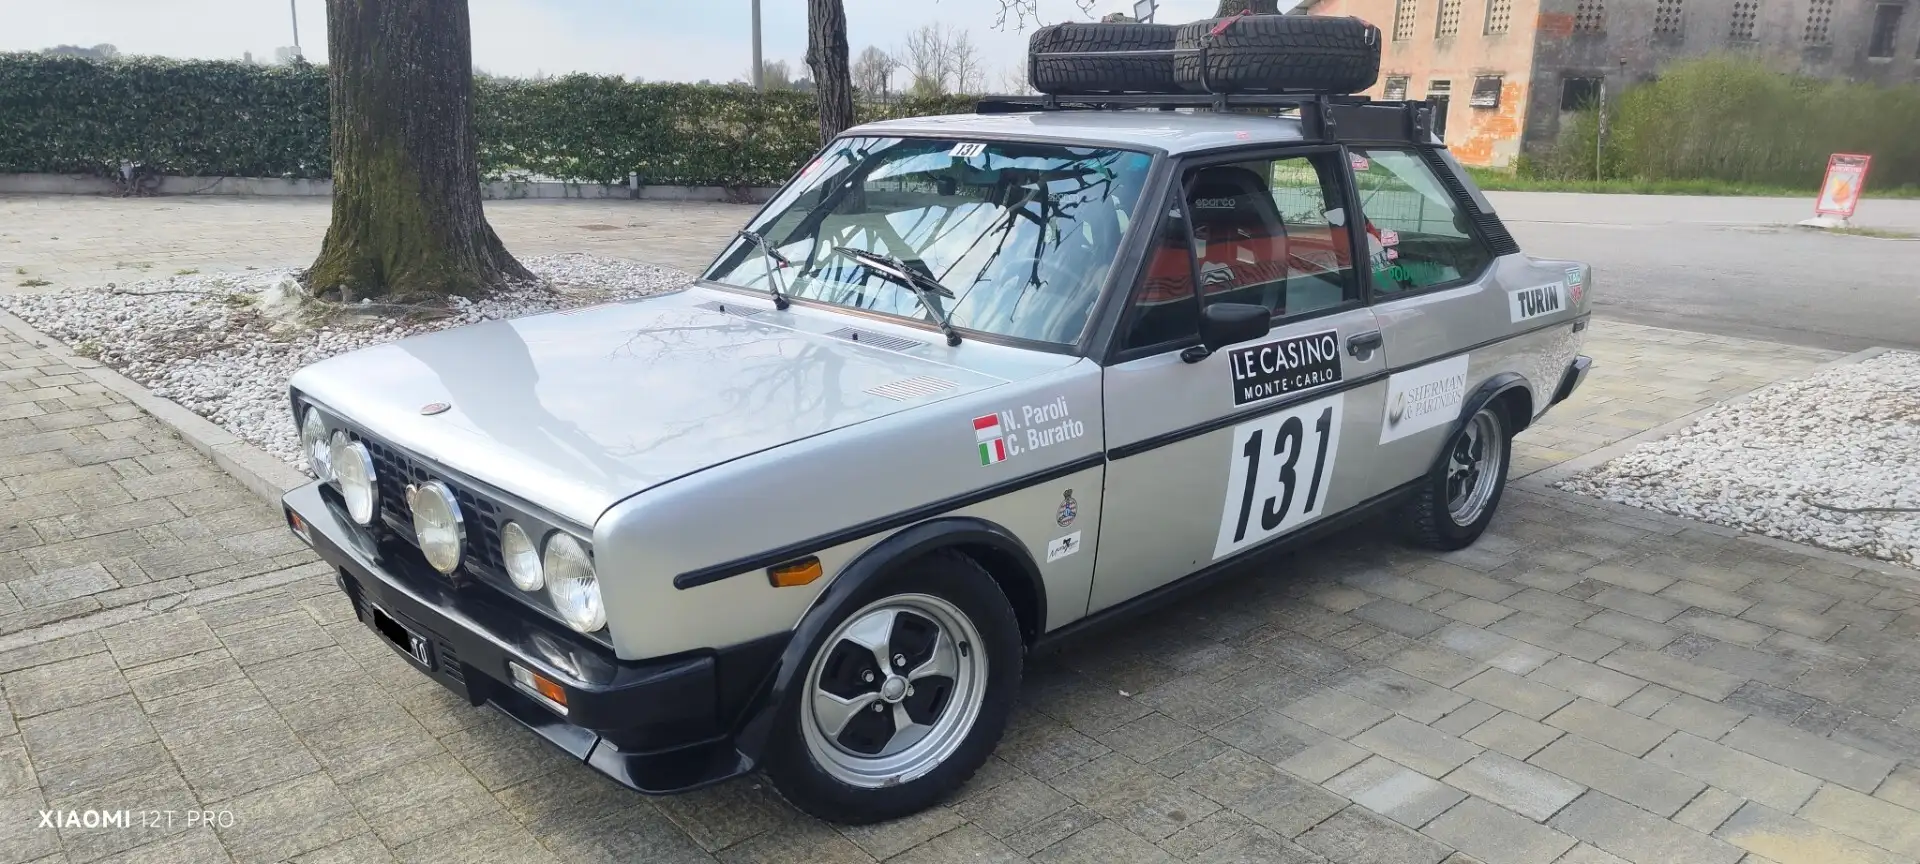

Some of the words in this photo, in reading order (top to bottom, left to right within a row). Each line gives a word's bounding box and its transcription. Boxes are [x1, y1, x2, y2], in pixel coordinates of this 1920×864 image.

[956, 144, 980, 156] 131
[1517, 285, 1559, 318] TURIN
[1233, 351, 1257, 380] LE
[1260, 335, 1336, 374] CASINO
[1404, 404, 1412, 421] &
[1415, 391, 1462, 417] PARTNERS
[1408, 373, 1465, 404] SHERMAN
[1001, 409, 1021, 432] N.
[1022, 395, 1069, 427] Paroli
[1007, 433, 1025, 456] C.
[1026, 419, 1084, 451] Buratto
[1233, 406, 1333, 543] 131
